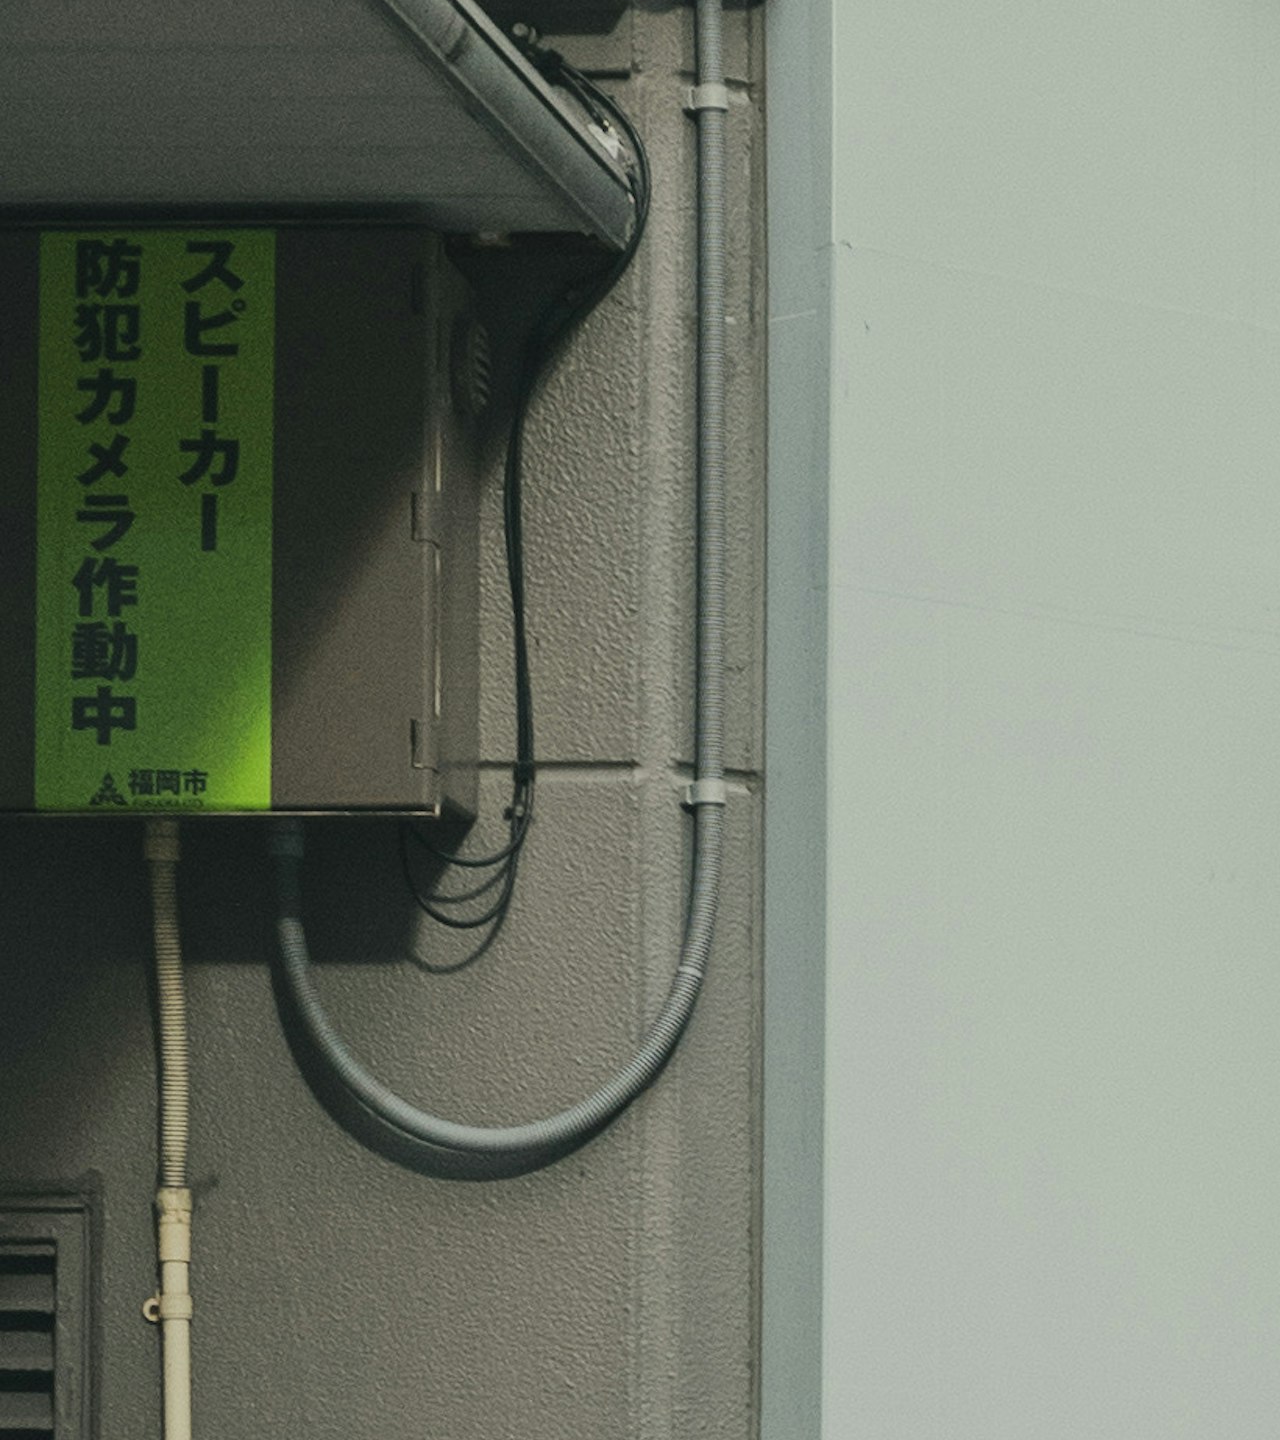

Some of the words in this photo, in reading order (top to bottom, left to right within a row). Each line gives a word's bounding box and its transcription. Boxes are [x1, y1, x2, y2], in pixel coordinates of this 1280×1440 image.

[70, 237, 143, 746] 防犯カメラ作動中
[178, 240, 245, 553] スピーカー
[127, 768, 208, 796] 福岡市
